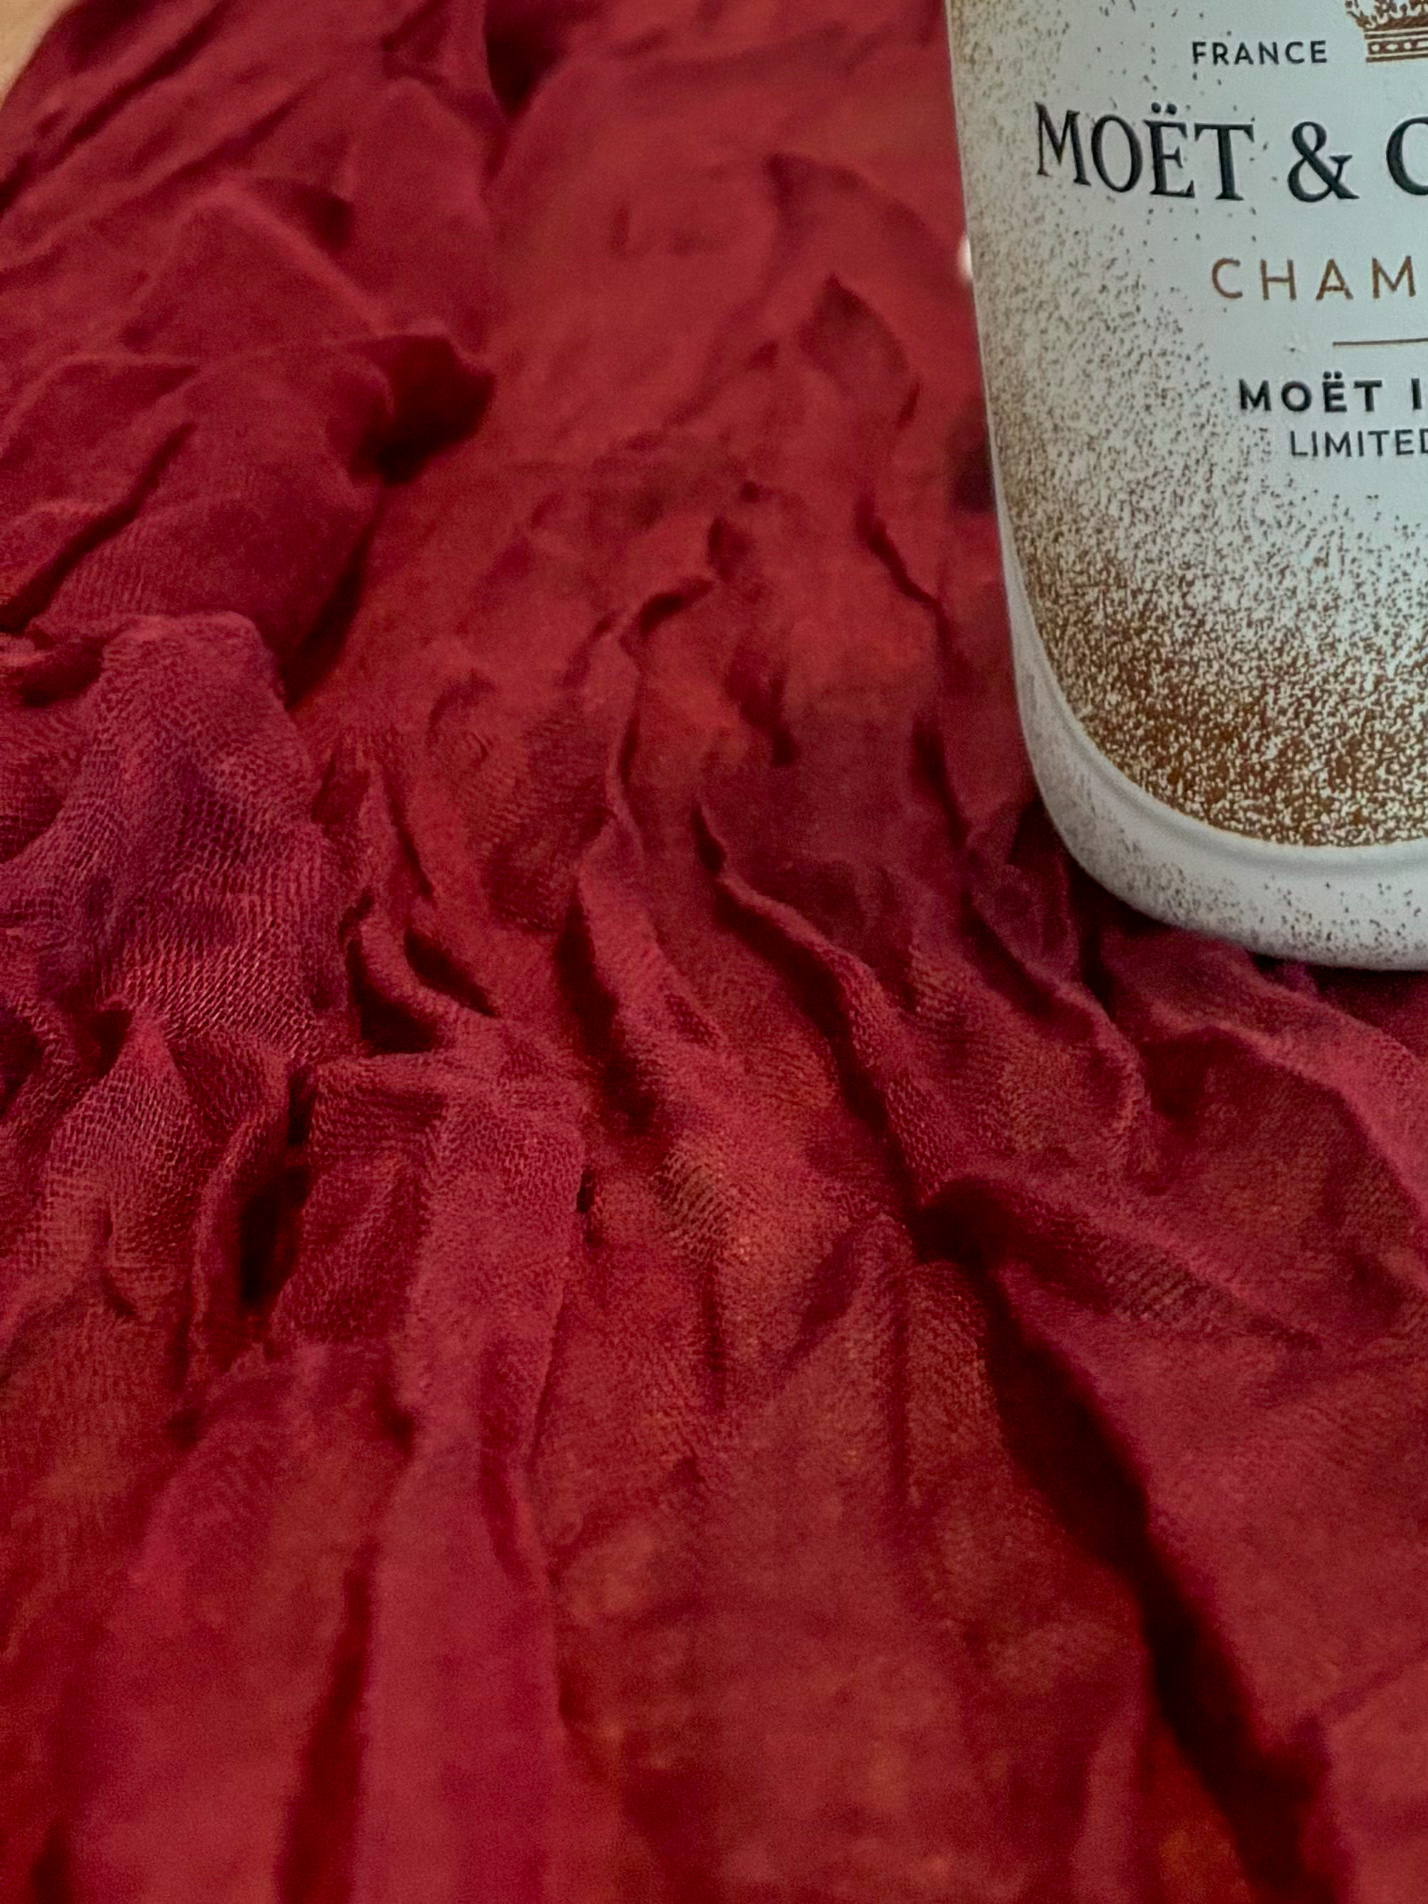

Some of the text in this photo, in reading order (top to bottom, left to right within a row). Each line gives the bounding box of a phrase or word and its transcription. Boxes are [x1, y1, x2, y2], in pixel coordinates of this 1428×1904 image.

[1191, 39, 1329, 66] FRANCE
[1034, 101, 1256, 202] MOËT
[1286, 120, 1361, 202] &
[1238, 370, 1383, 413] MOËT
